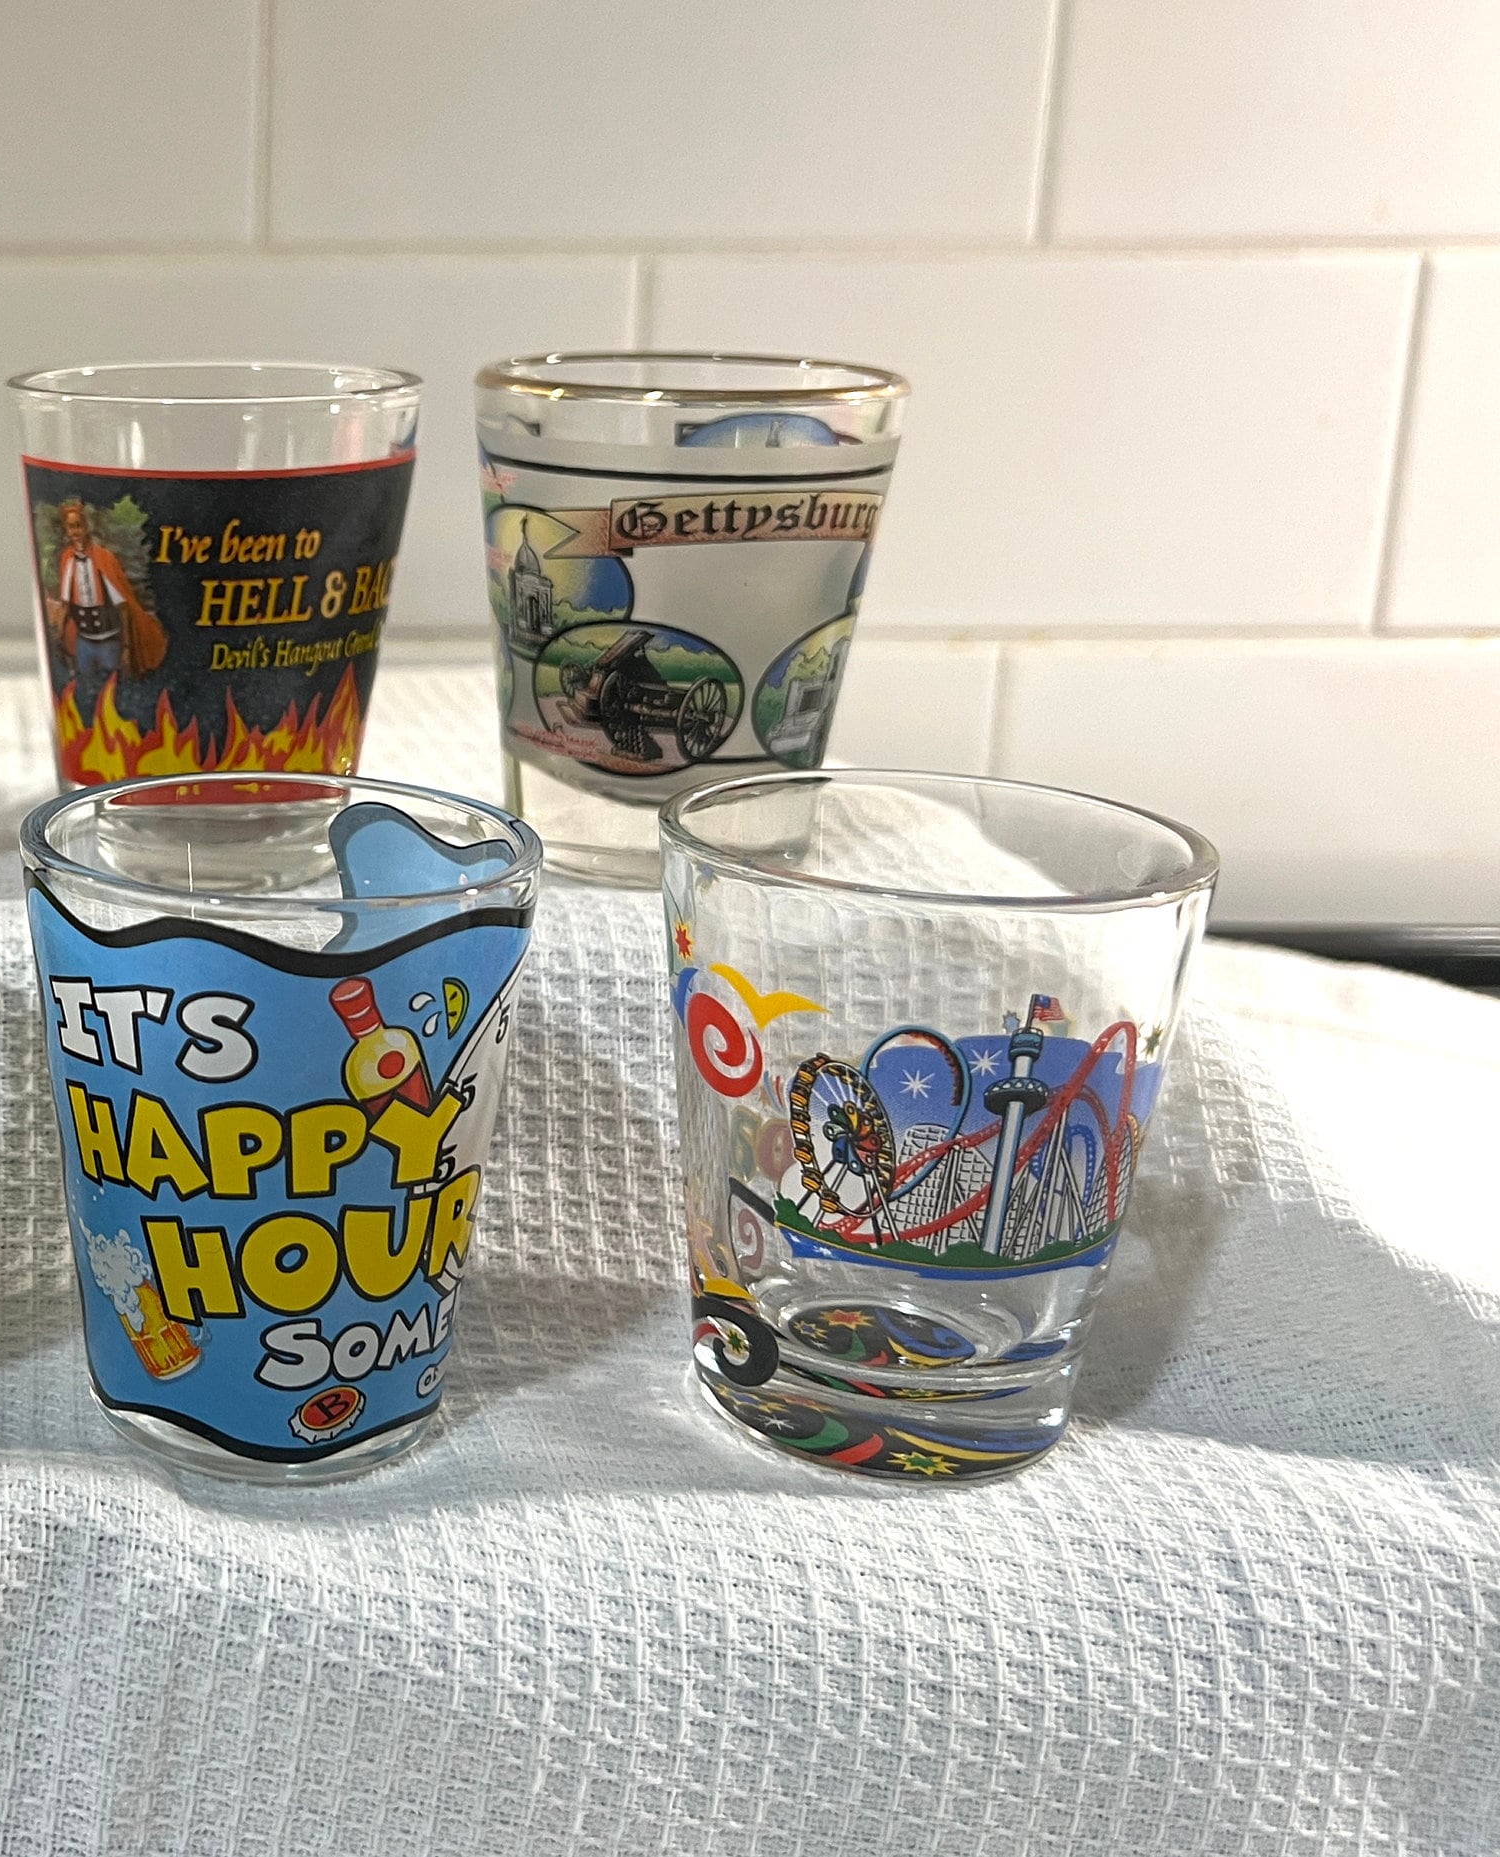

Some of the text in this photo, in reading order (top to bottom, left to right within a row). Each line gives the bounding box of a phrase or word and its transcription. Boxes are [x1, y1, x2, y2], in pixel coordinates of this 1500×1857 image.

[156, 519, 322, 565] I've been to
[195, 558, 393, 629] HELL & BAC
[209, 634, 271, 671] Devil's
[273, 627, 344, 678] Hangout
[49, 976, 258, 1083] IT'S
[65, 1079, 464, 1200] HAPPY
[140, 1163, 481, 1323] HOUR
[254, 1288, 459, 1391] SOME
[310, 1392, 350, 1426] B
